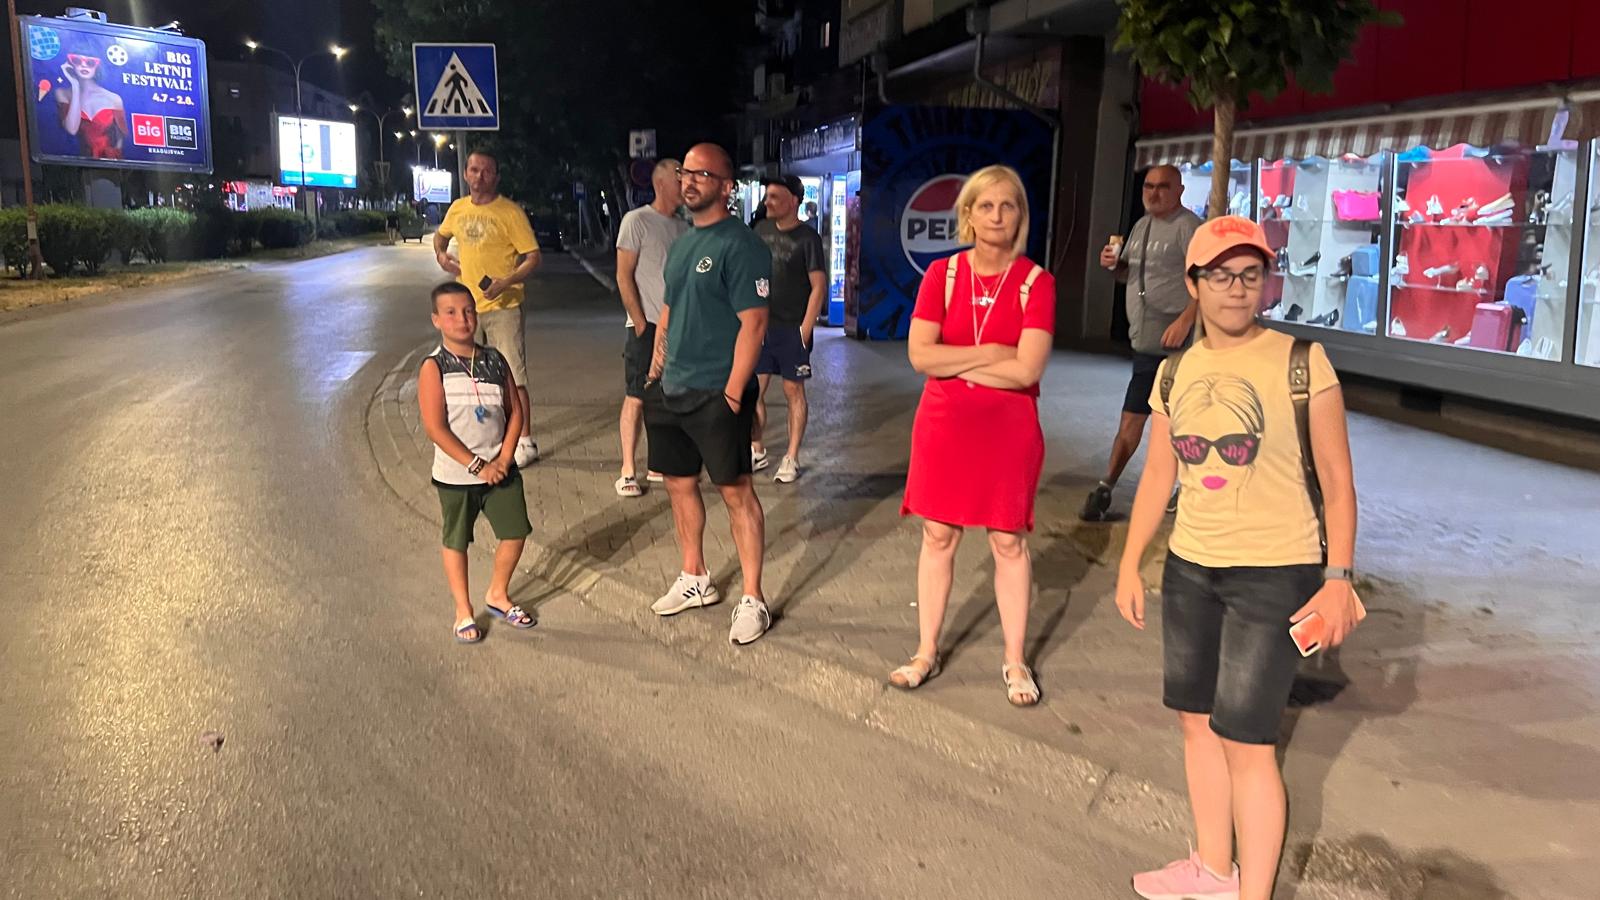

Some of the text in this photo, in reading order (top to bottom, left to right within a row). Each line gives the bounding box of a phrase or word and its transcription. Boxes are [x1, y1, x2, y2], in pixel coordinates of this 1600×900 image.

[166, 51, 191, 65] BIG
[144, 62, 192, 79] LETNJI
[122, 72, 193, 91] FESTIVAL!
[170, 124, 192, 136] BIG
